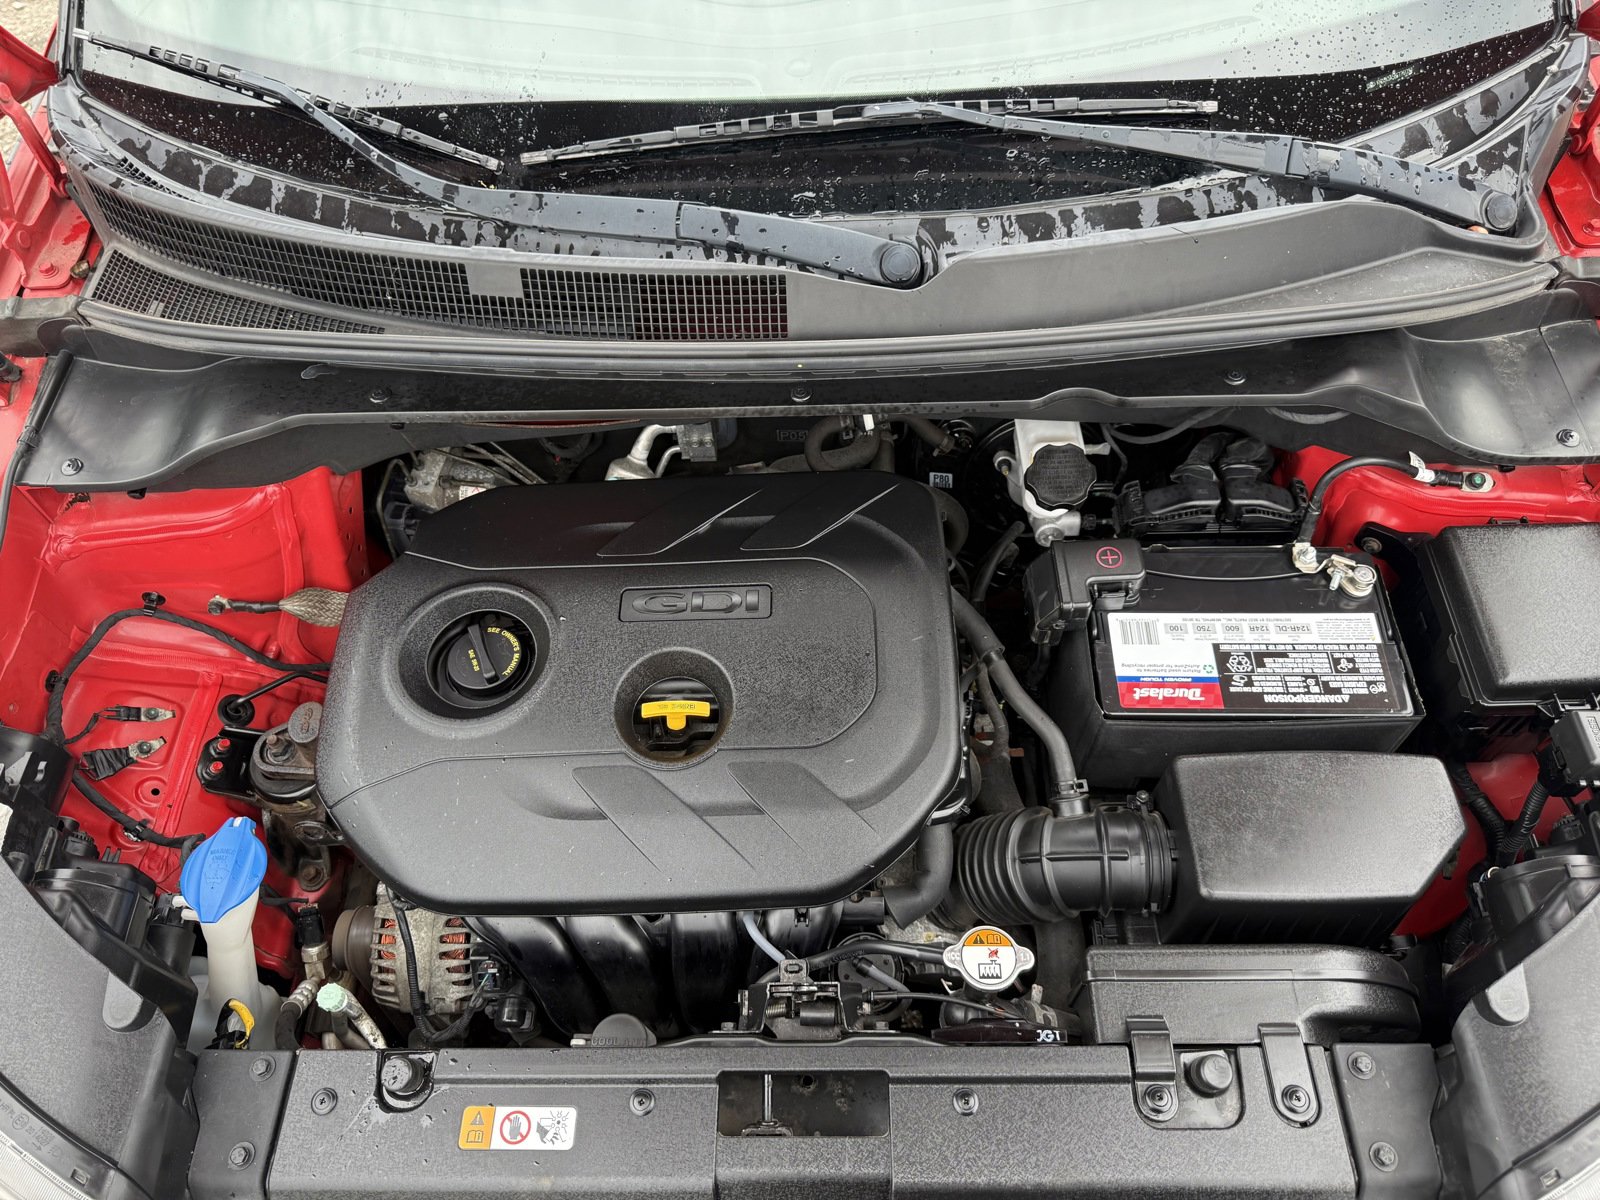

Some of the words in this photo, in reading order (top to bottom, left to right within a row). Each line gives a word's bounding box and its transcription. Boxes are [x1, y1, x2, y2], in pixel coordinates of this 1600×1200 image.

[632, 590, 759, 614] GDI
[502, 630, 520, 651] OWNER'S
[502, 653, 519, 675] MANUAL
[1133, 688, 1205, 700] Duralast
[1264, 694, 1342, 702] DANGER/POISON
